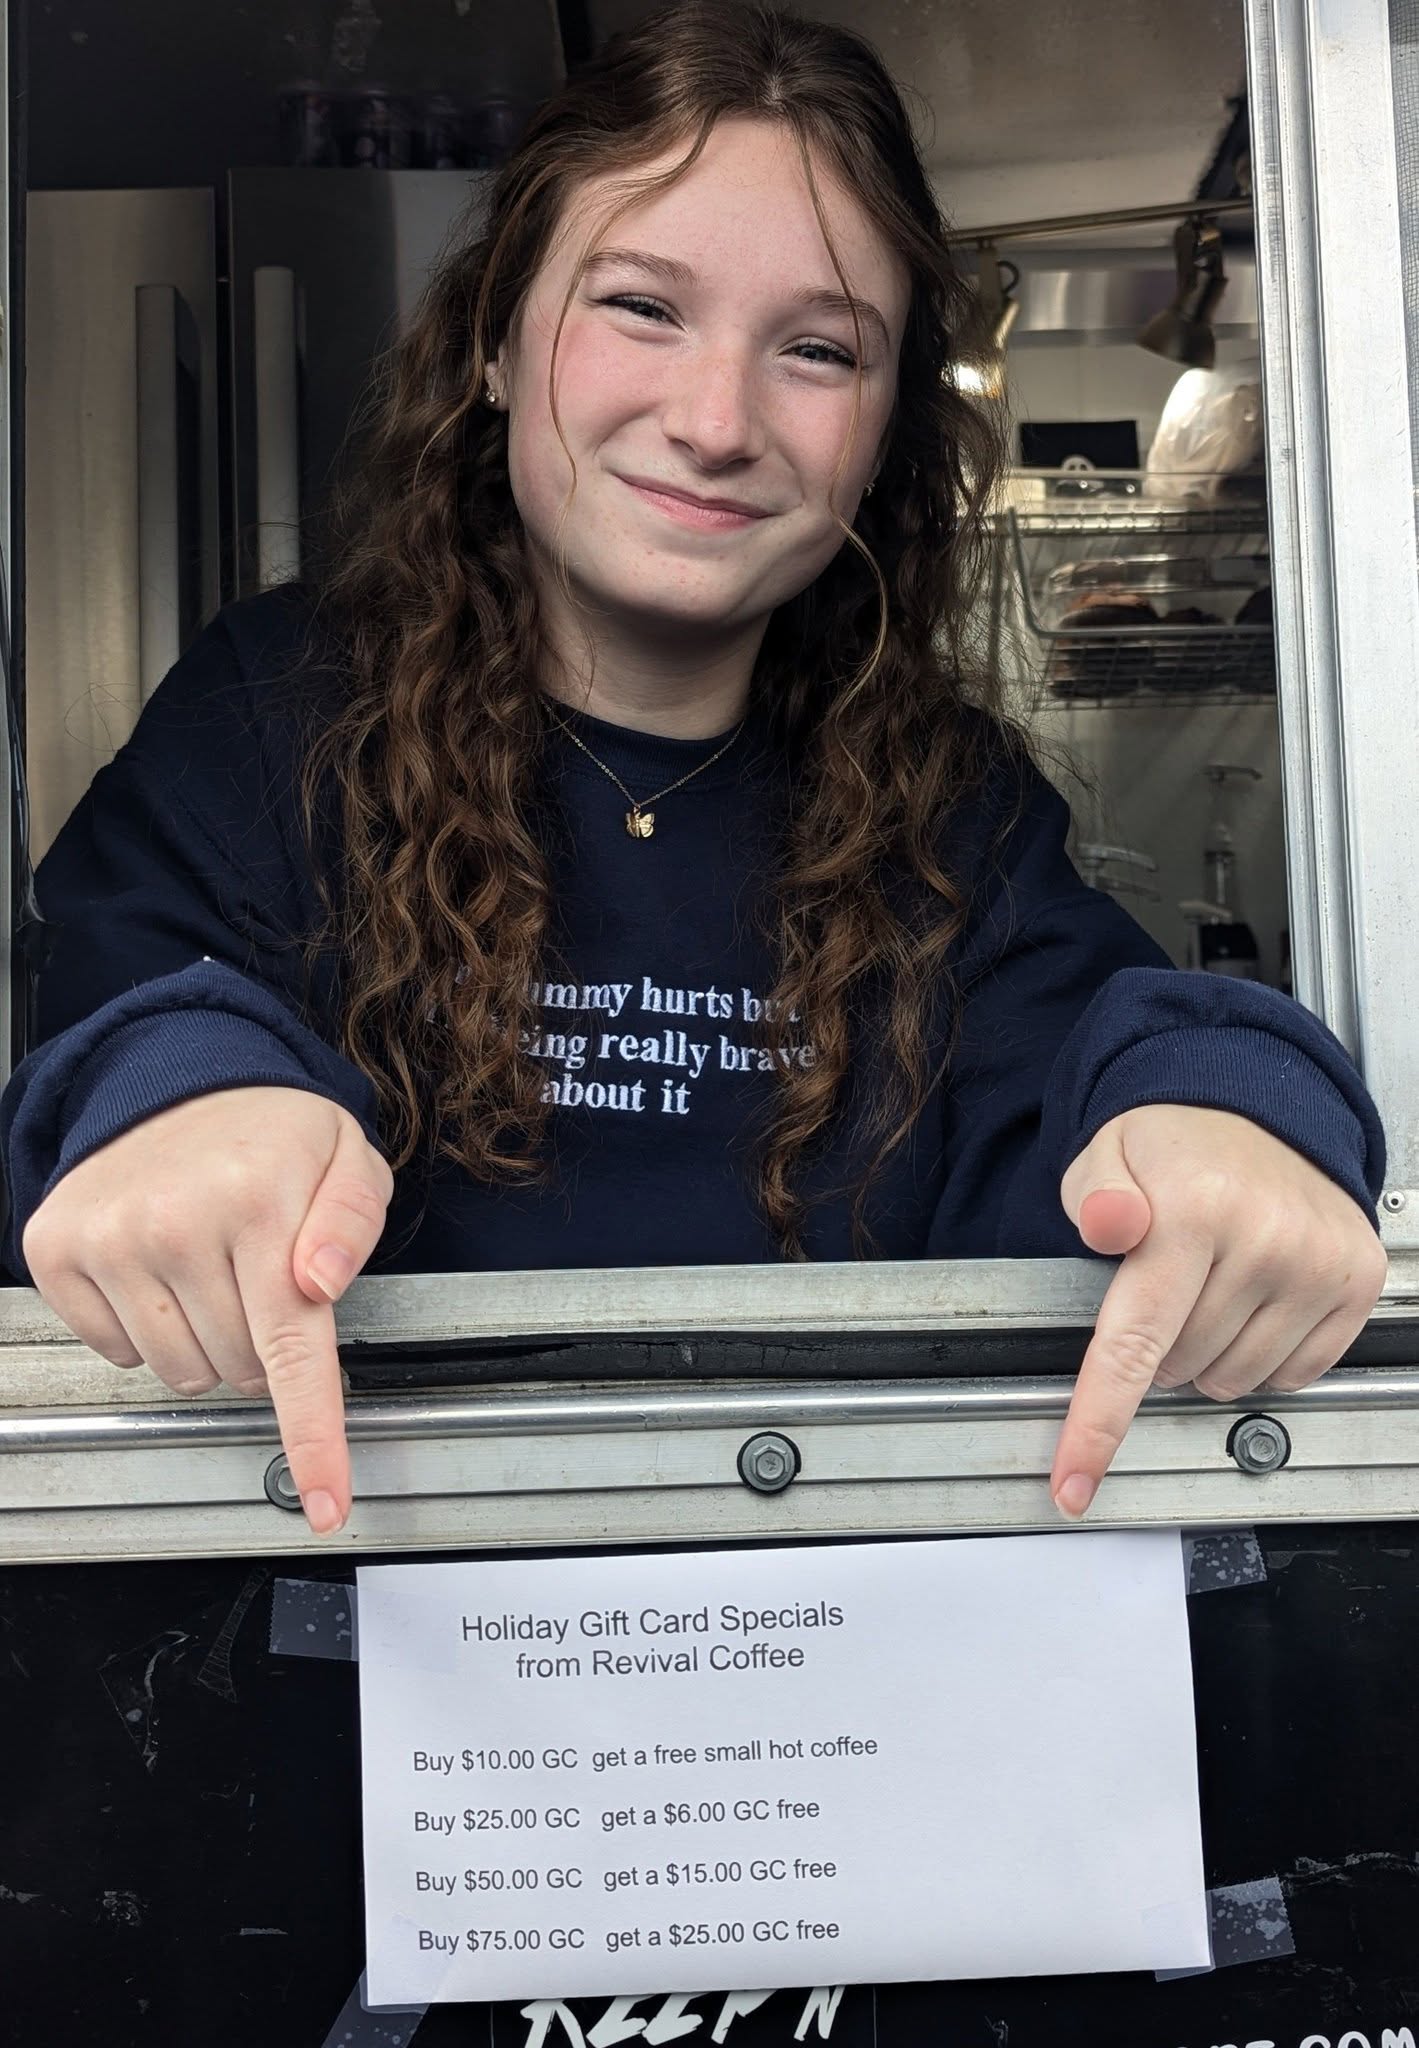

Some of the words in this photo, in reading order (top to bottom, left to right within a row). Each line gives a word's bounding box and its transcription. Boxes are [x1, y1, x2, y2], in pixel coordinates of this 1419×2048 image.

[640, 976, 734, 1019] hurts
[597, 1029, 712, 1079] really
[719, 1034, 816, 1071] brave
[540, 1073, 647, 1113] about
[660, 1079, 692, 1114] it
[462, 1613, 570, 1644] Holiday
[579, 1610, 631, 1638] Gift
[639, 1606, 709, 1635] Card
[720, 1601, 844, 1636] Specials
[516, 1652, 581, 1678] from
[592, 1646, 699, 1676] Revival
[709, 1643, 805, 1671] Coffee
[413, 1751, 455, 1776] Buy
[461, 1748, 535, 1773] $10.00
[542, 1748, 578, 1769] GC
[592, 1747, 628, 1773] get
[634, 1749, 648, 1766] a
[653, 1744, 697, 1765] free
[704, 1739, 762, 1763] small
[768, 1739, 805, 1760] hot
[810, 1735, 878, 1758] coffee
[414, 1811, 457, 1836] Buy
[463, 1808, 537, 1833] $25.00
[544, 1807, 581, 1829] GC
[601, 1806, 637, 1833] get
[643, 1809, 657, 1825] a
[663, 1801, 726, 1827] $6.00
[733, 1799, 770, 1822] GC
[776, 1798, 820, 1820] free
[415, 1871, 457, 1897] Buy
[464, 1868, 539, 1893] $50.00
[546, 1867, 583, 1889] GC
[603, 1866, 640, 1893] get
[645, 1869, 659, 1886] a
[666, 1861, 742, 1887] $15.00
[749, 1859, 787, 1882] GC
[792, 1858, 837, 1879] free
[418, 1930, 460, 1956] Buy
[466, 1928, 541, 1953] $75.00
[548, 1927, 585, 1950] GC
[605, 1927, 642, 1953] get
[647, 1930, 662, 1947] a
[668, 1922, 745, 1948] $25.00
[752, 1920, 790, 1942] GC
[795, 1919, 840, 1940] free
